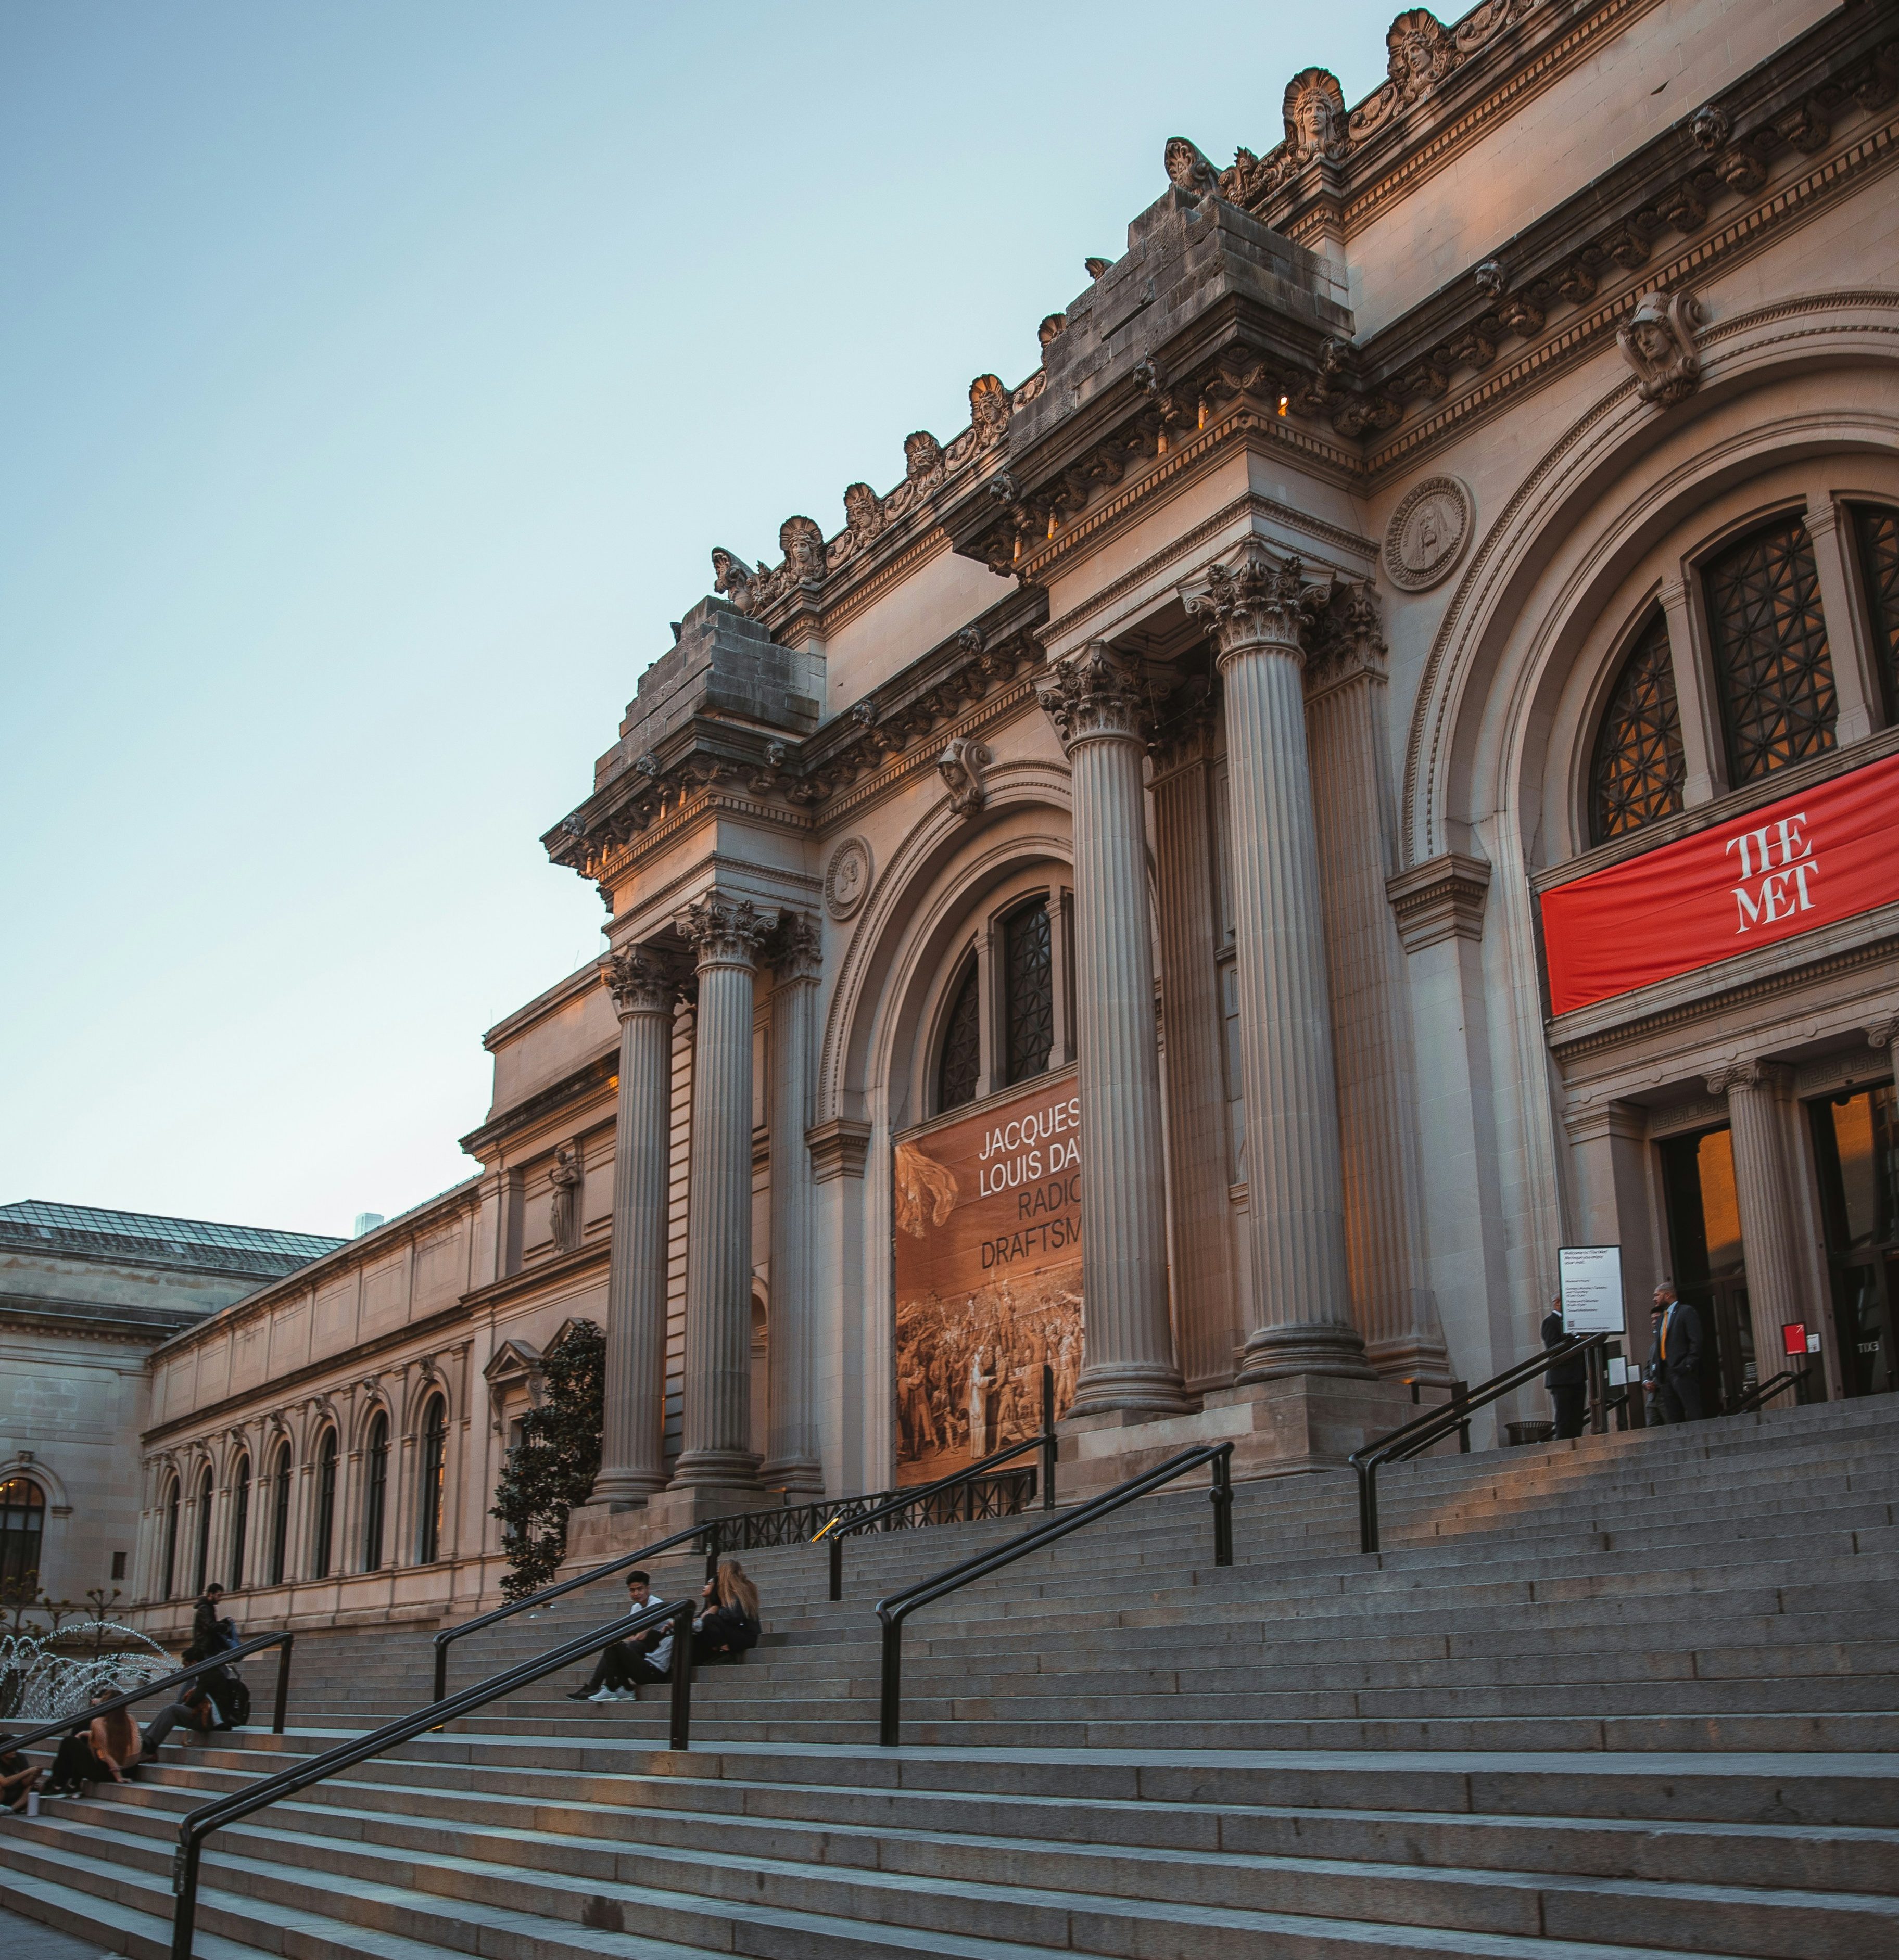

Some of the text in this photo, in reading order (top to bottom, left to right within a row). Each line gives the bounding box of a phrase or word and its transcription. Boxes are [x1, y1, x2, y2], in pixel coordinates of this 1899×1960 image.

[1726, 812, 1812, 881] THE
[1730, 860, 1819, 934] MET
[979, 1098, 1080, 1160] JACQUES
[979, 1135, 1080, 1197] LOUIS DA
[982, 1214, 1082, 1269] DRAFTSM
